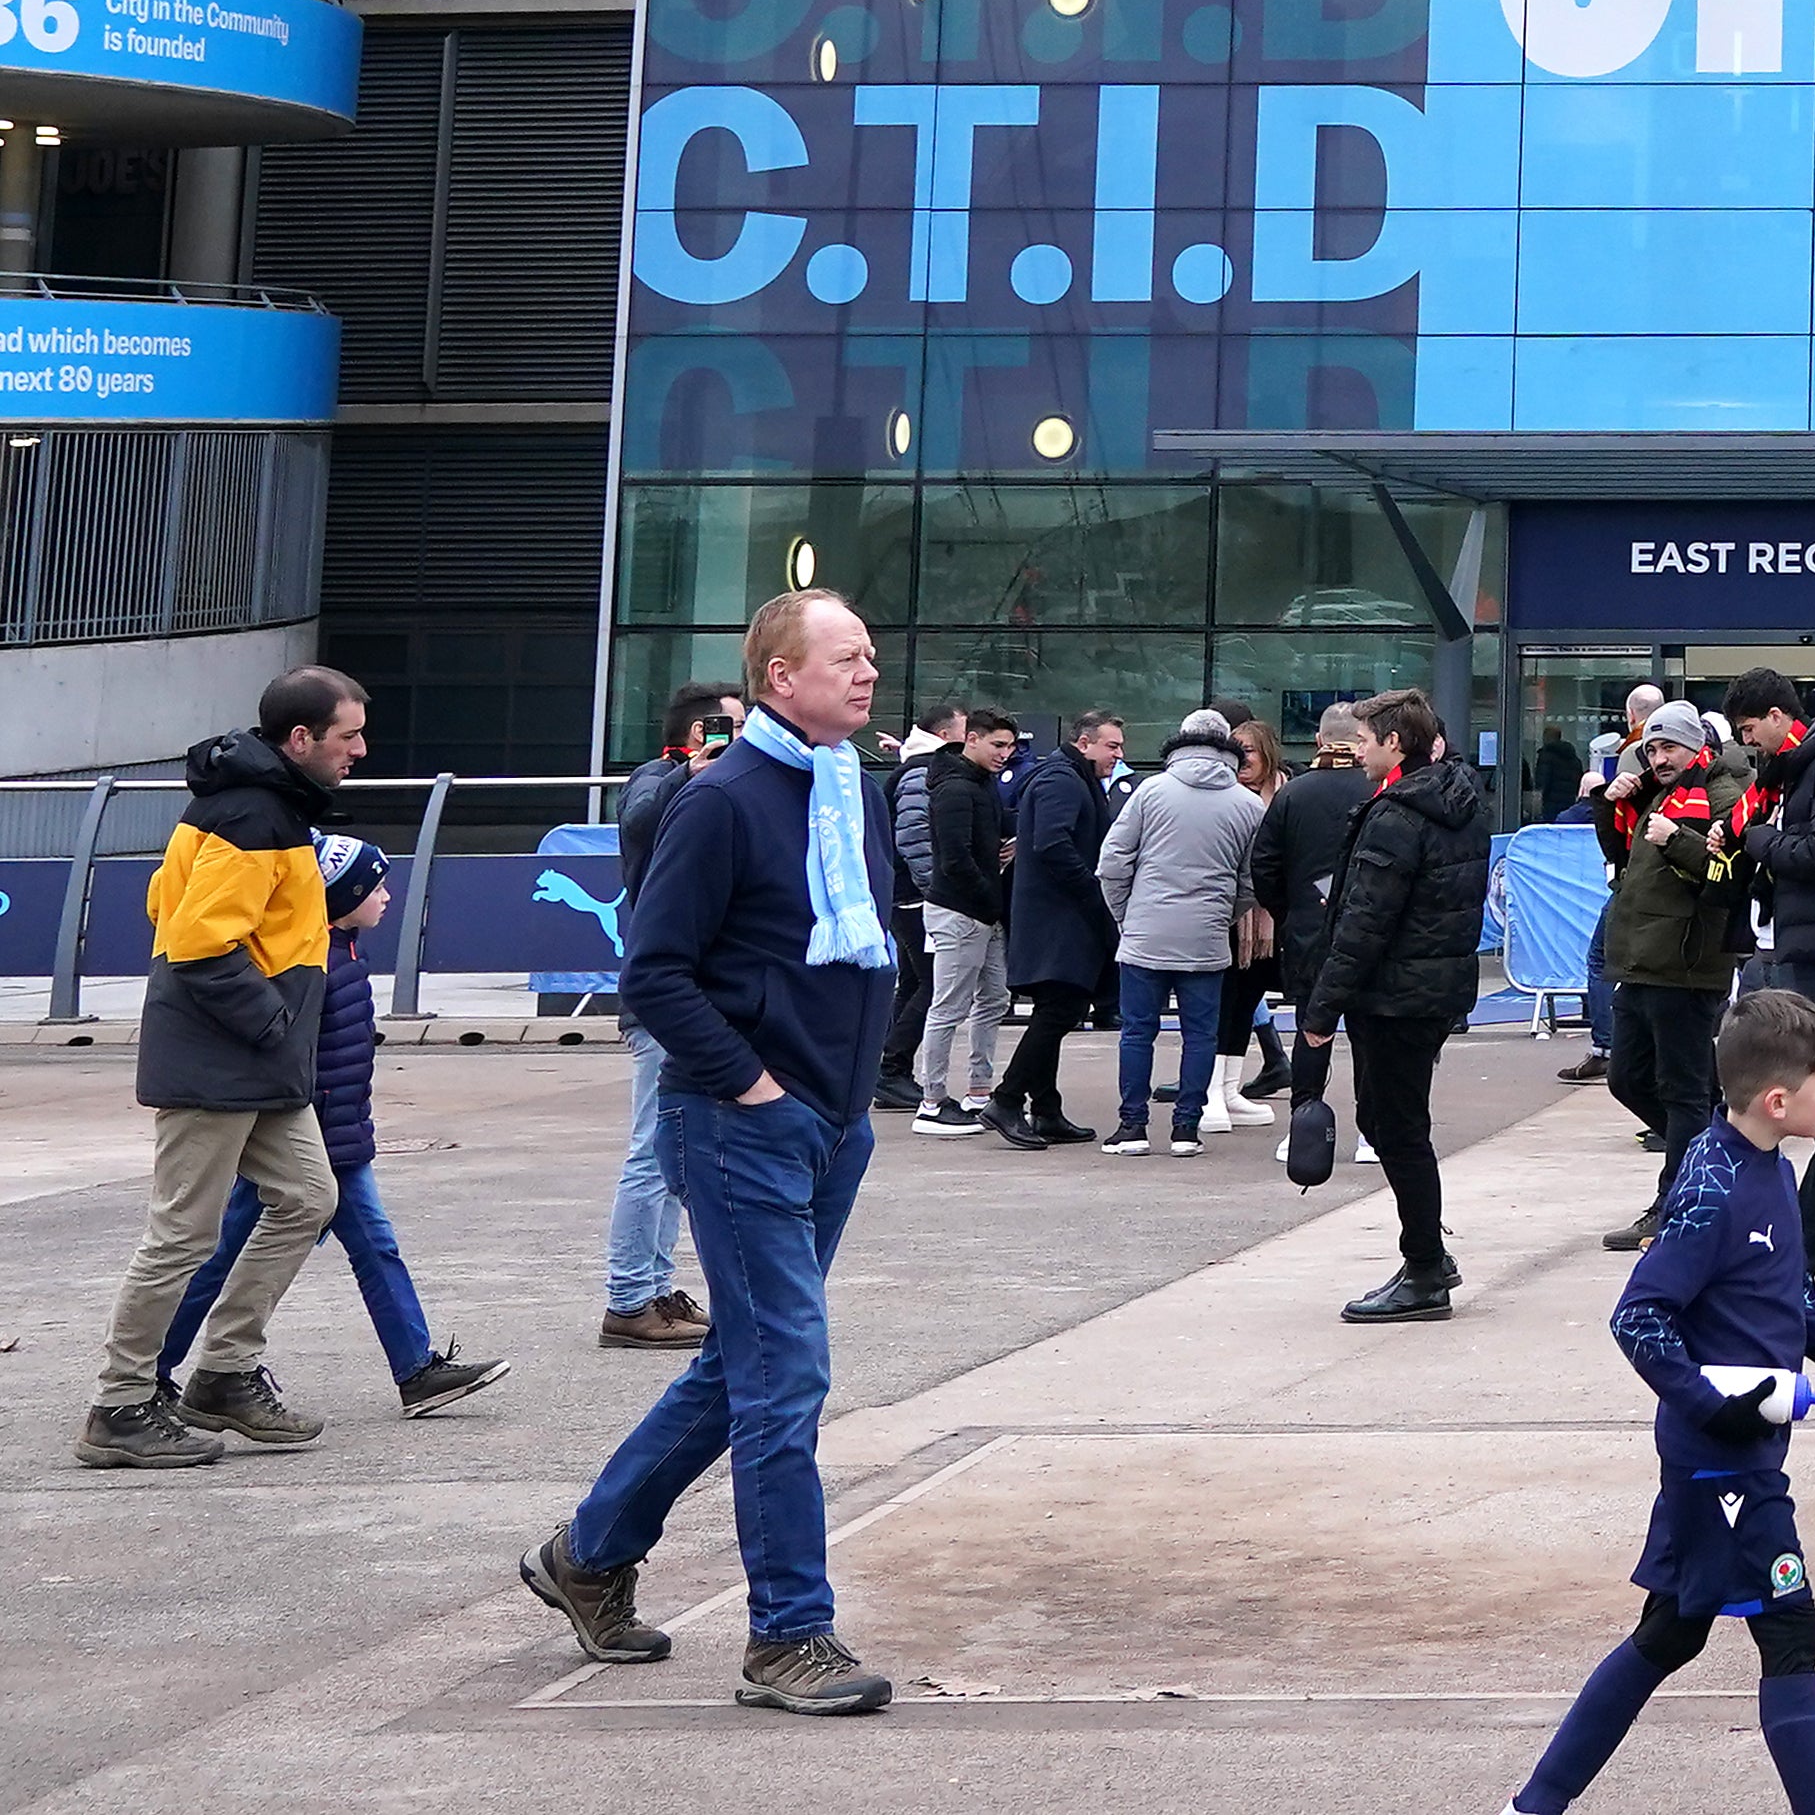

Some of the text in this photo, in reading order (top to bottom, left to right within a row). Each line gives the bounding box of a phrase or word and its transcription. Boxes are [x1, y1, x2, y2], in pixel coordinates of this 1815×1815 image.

[153, 0, 170, 20] in
[207, 2, 288, 46] Community
[104, 25, 205, 61] is founded
[634, 85, 1427, 304] C.T.I.D
[28, 327, 98, 354] which
[104, 329, 190, 356] becomes
[0, 365, 153, 398] next 80 years
[1631, 543, 1735, 573] EAST
